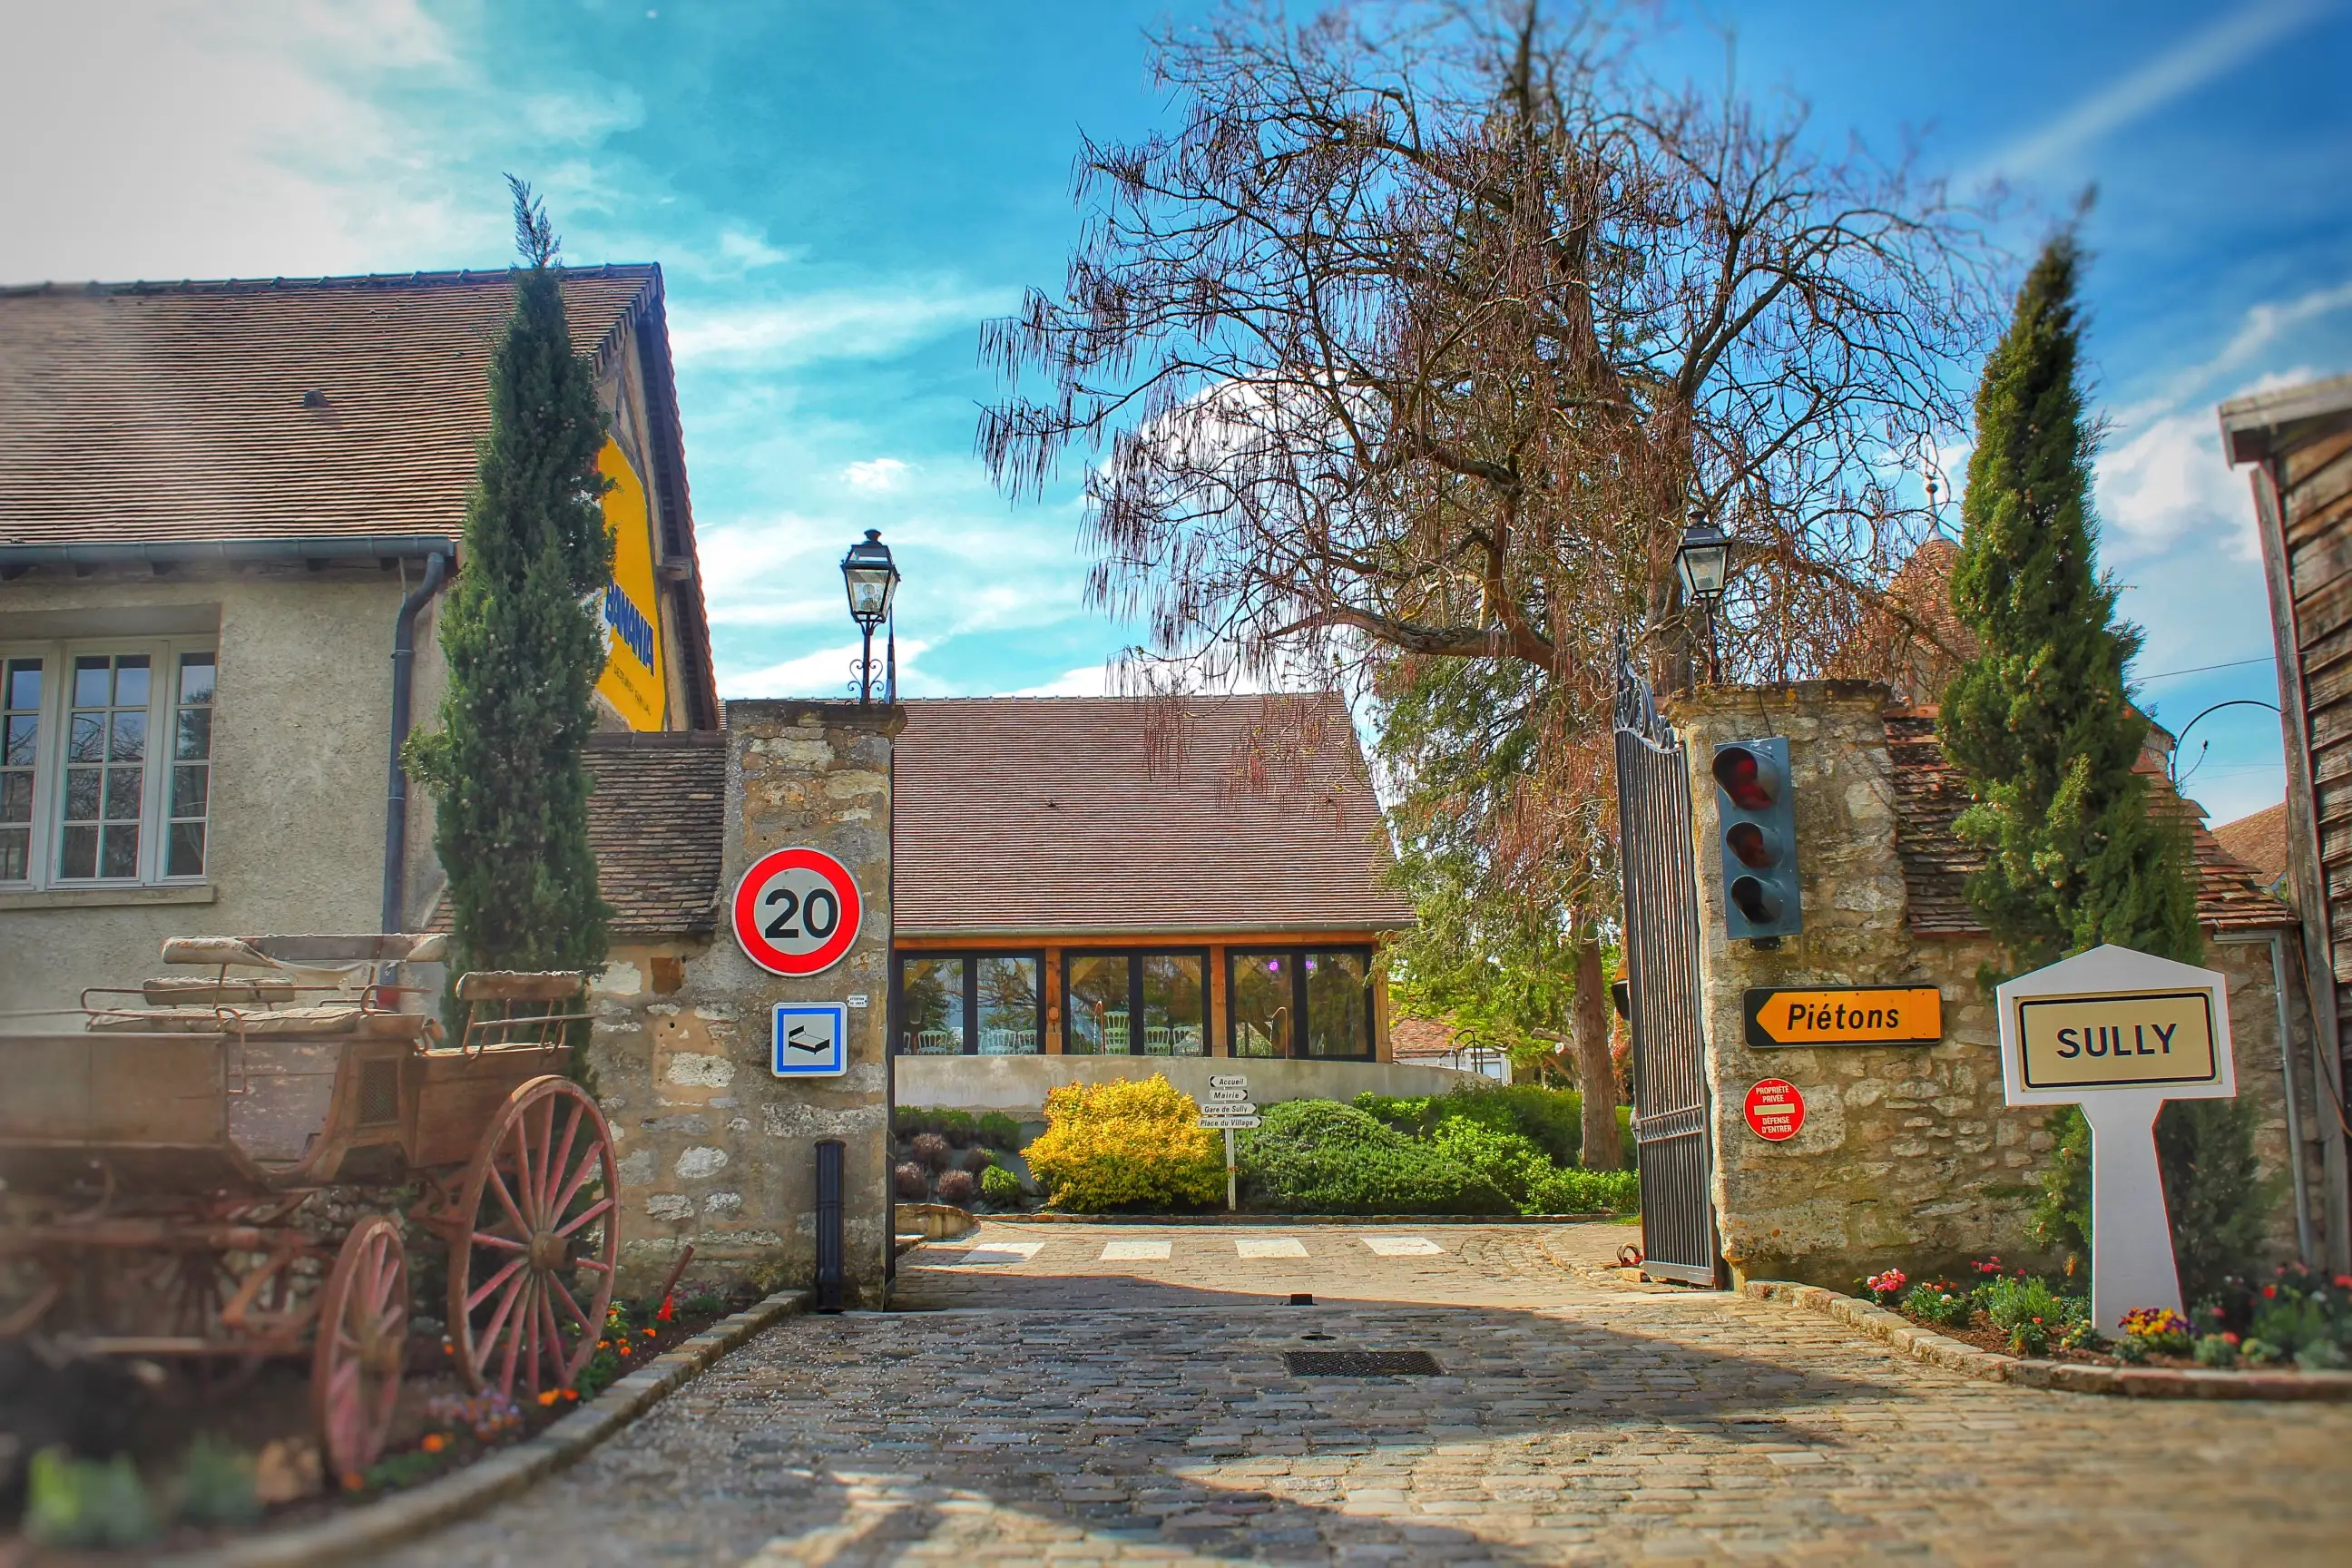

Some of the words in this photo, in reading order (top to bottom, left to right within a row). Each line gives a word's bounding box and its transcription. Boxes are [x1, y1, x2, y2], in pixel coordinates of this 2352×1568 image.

[605, 577, 655, 678] BANANIA
[764, 888, 838, 939] 20
[1787, 1004, 1899, 1031] Piétons
[2056, 1024, 2177, 1059] SULLY
[1756, 1084, 1789, 1094] PROPRIÉTÉ
[1762, 1093, 1785, 1102] PRIVÉE
[1761, 1116, 1790, 1125] DÉFENSE
[1761, 1125, 1792, 1134] D'ENTRER
